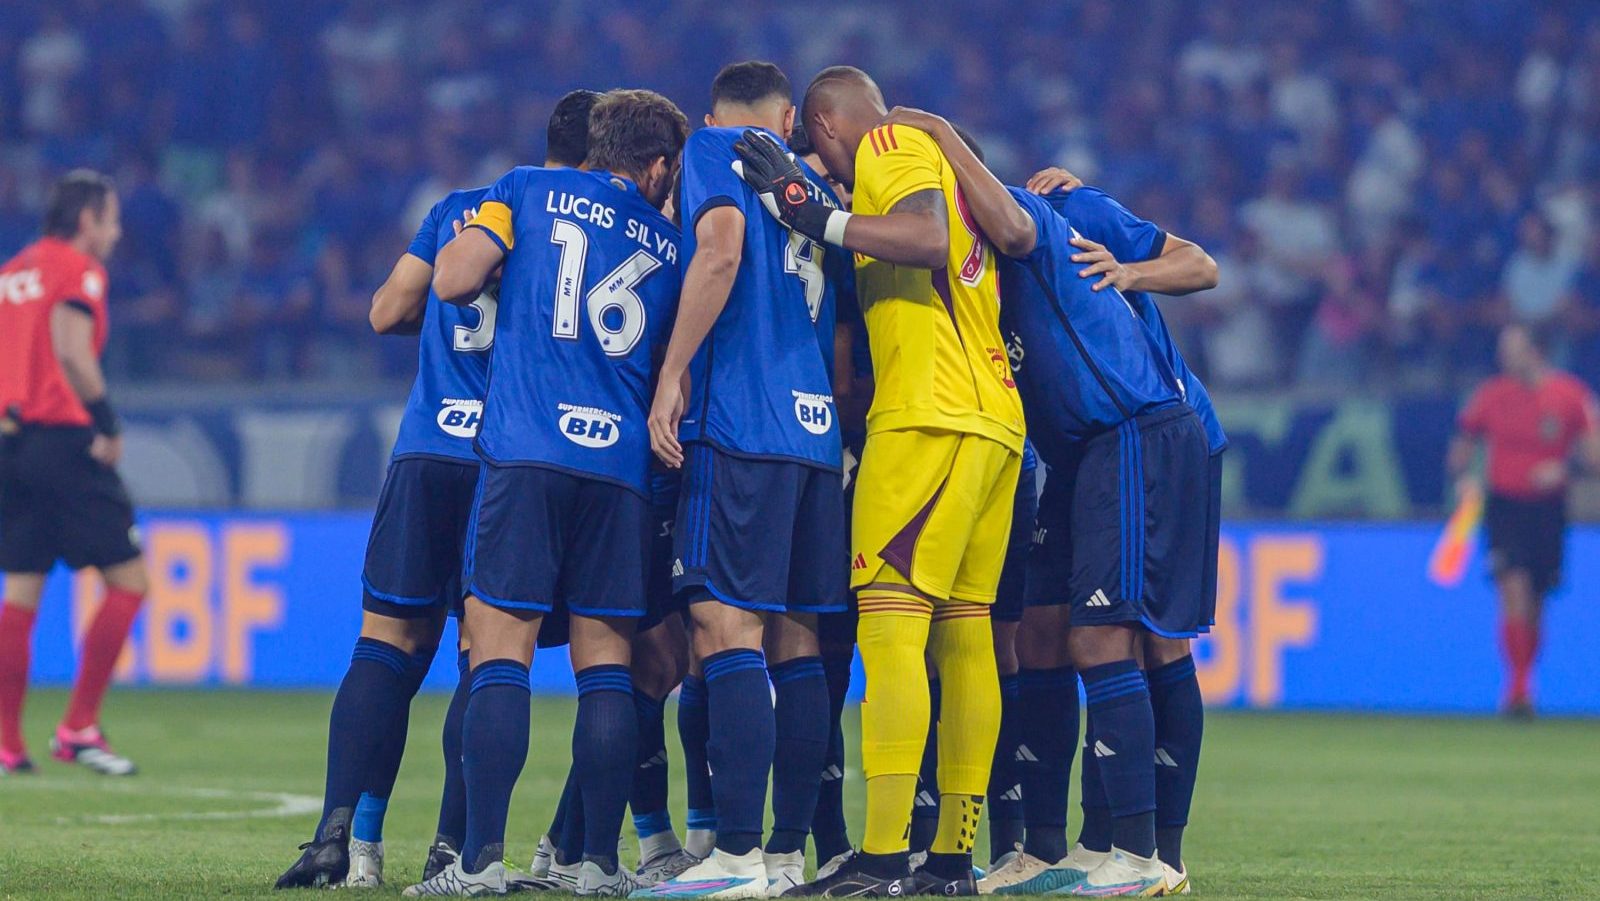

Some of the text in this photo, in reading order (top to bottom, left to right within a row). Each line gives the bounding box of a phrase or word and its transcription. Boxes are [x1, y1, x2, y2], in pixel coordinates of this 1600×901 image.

[546, 190, 677, 265] LUCAS SILVA
[550, 218, 663, 356] 16
[557, 402, 622, 422] SUPERMERCADOS
[799, 403, 827, 427] BH
[565, 416, 613, 441] BH
